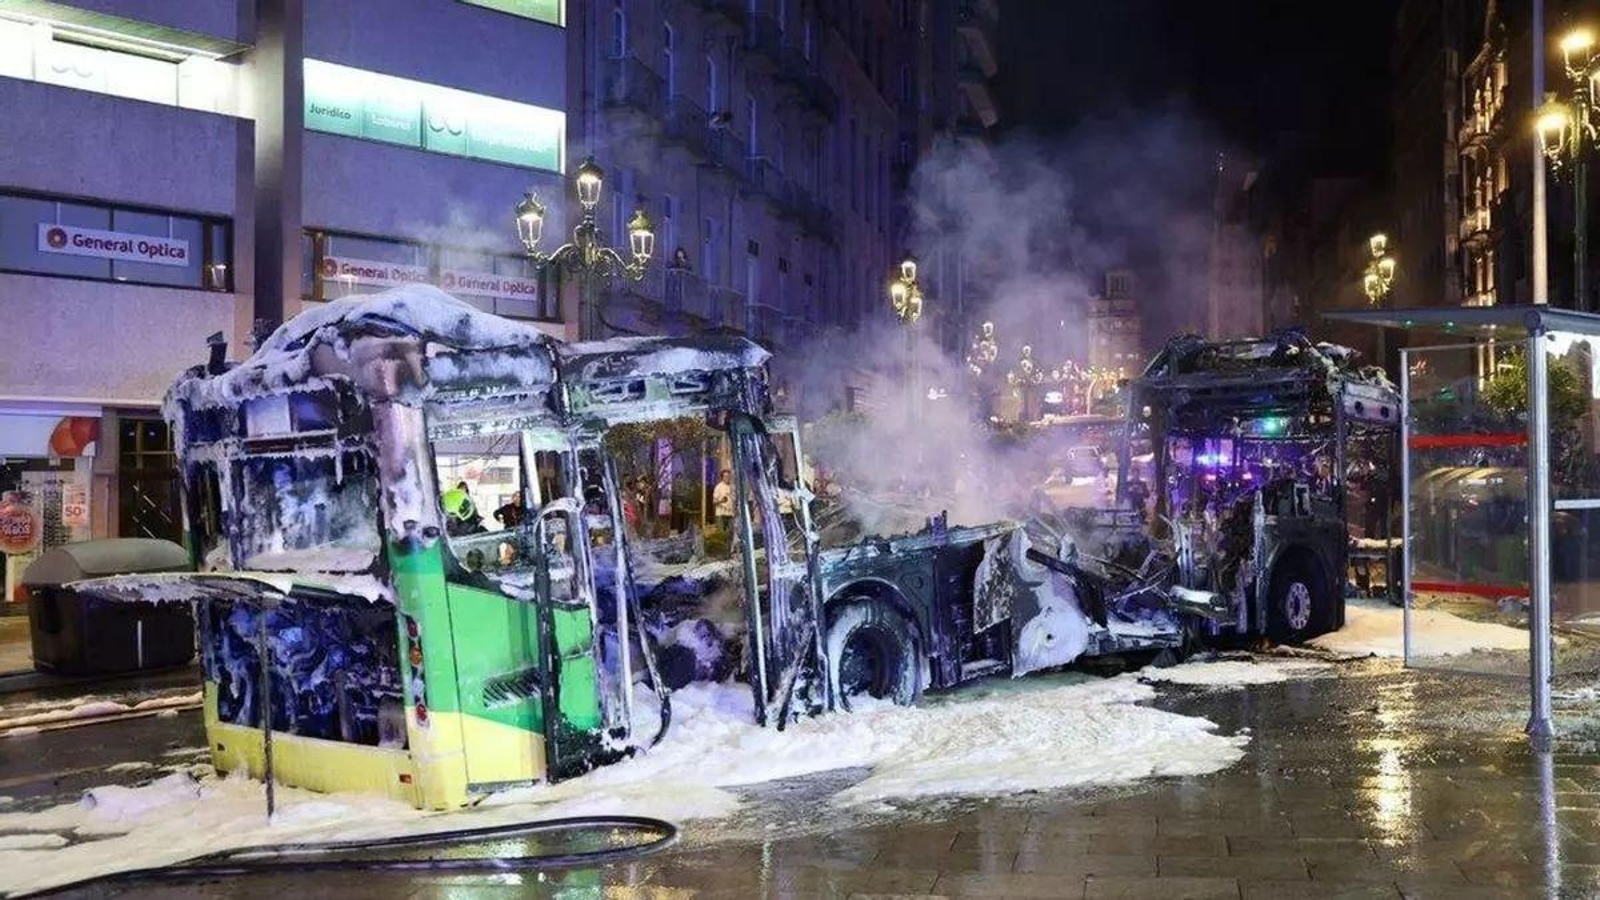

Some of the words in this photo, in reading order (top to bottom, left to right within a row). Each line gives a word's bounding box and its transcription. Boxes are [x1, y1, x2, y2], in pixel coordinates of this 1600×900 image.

[72, 234, 133, 253] General
[137, 241, 186, 259] Optica
[341, 262, 388, 280] General
[457, 276, 501, 292] General
[503, 279, 536, 295] Optica
